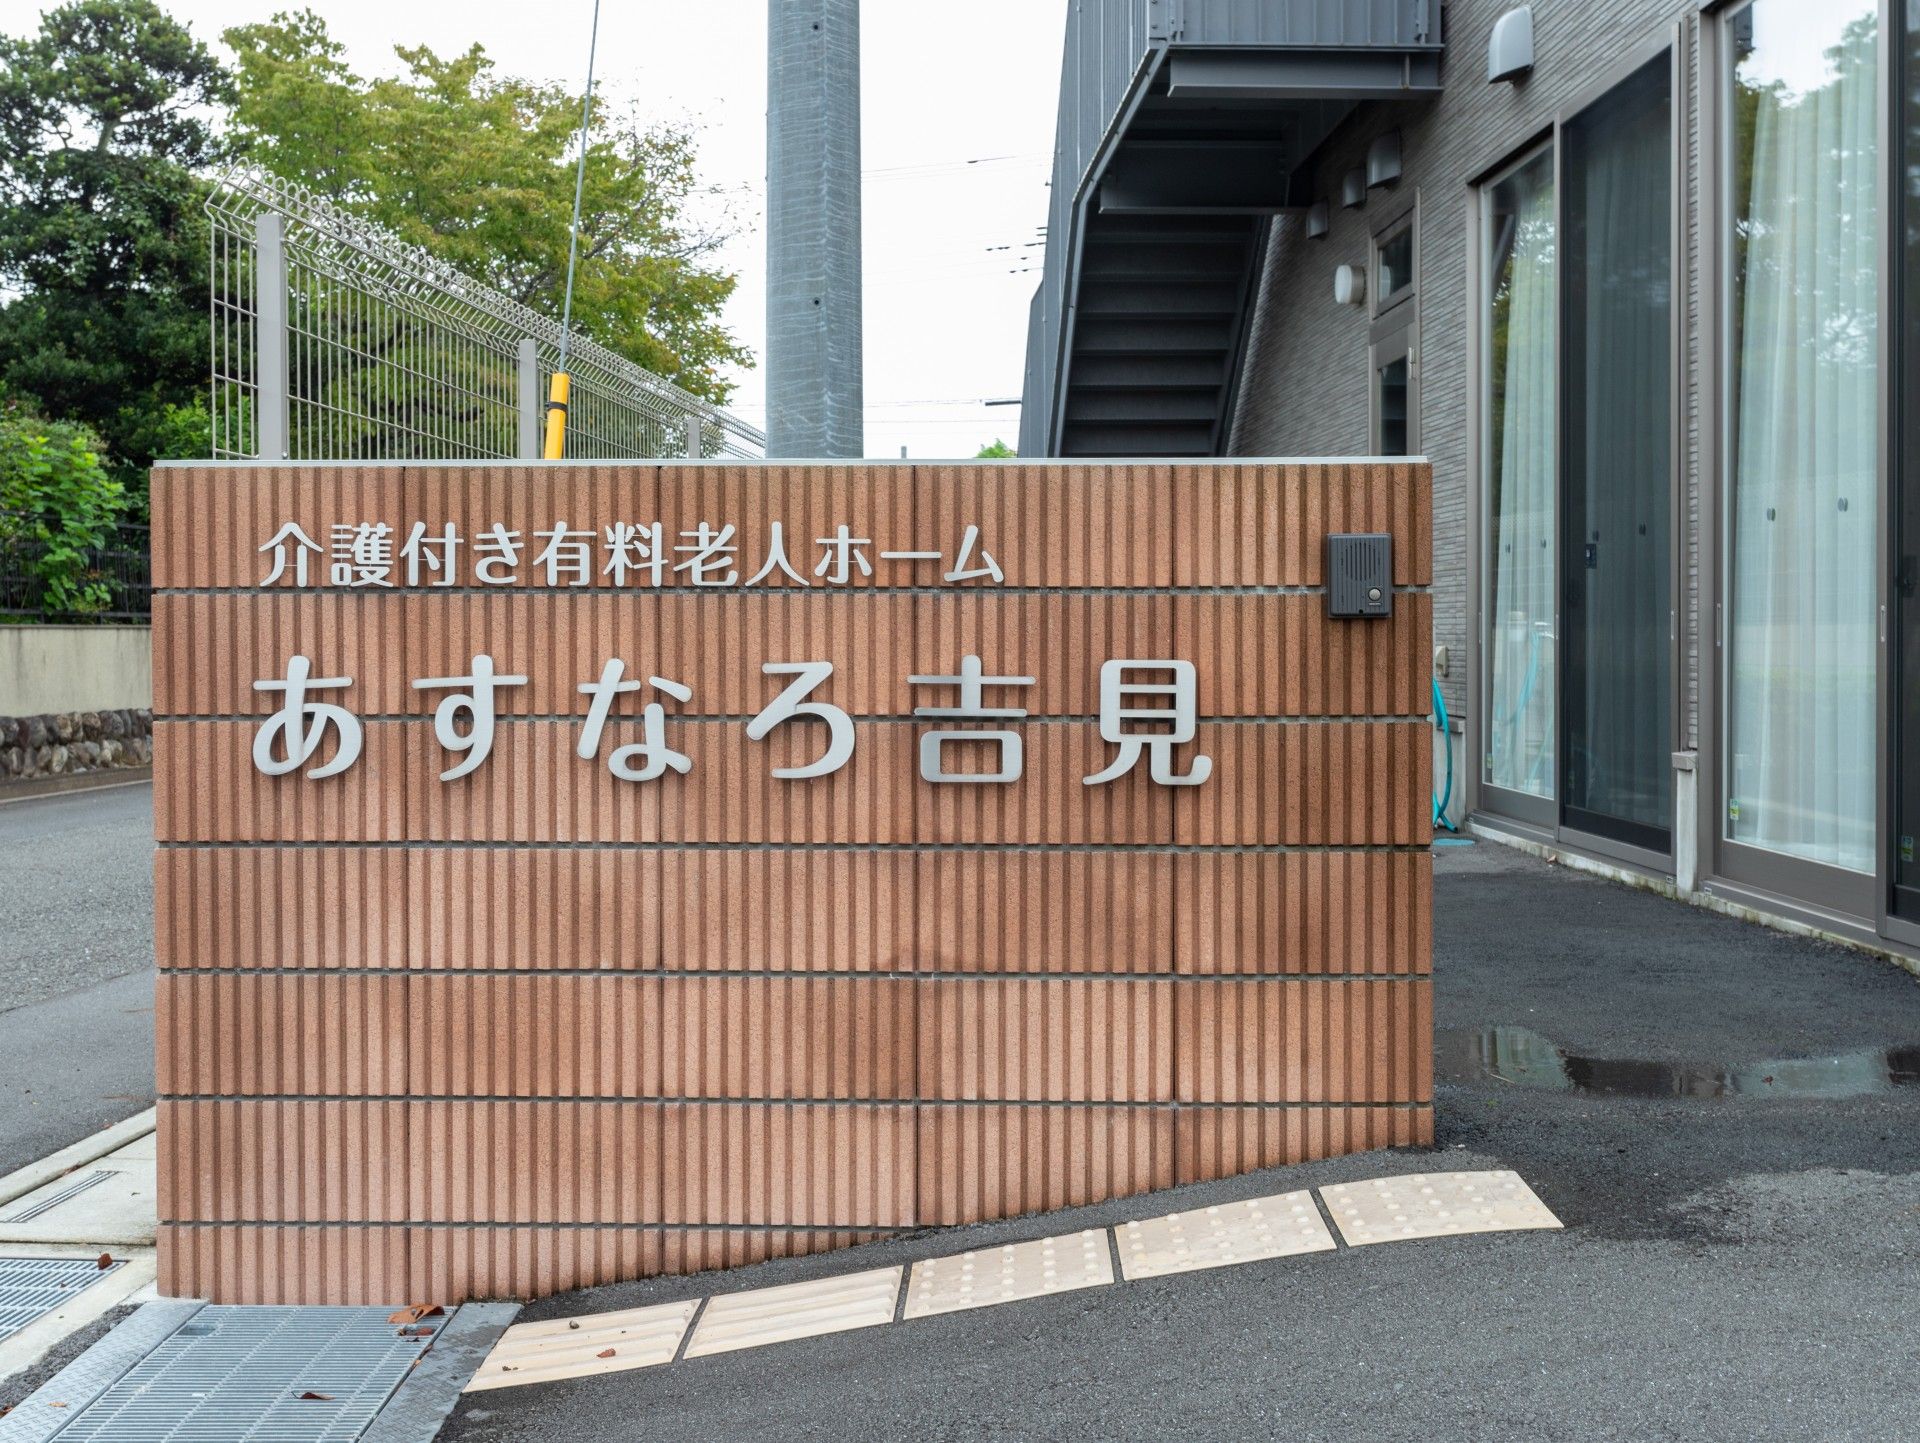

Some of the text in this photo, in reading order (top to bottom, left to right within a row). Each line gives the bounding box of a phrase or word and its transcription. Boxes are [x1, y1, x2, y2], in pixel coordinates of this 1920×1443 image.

[258, 521, 1004, 587] 介護付き有料老人ホーム
[252, 654, 1213, 786] あすなろ吉見
